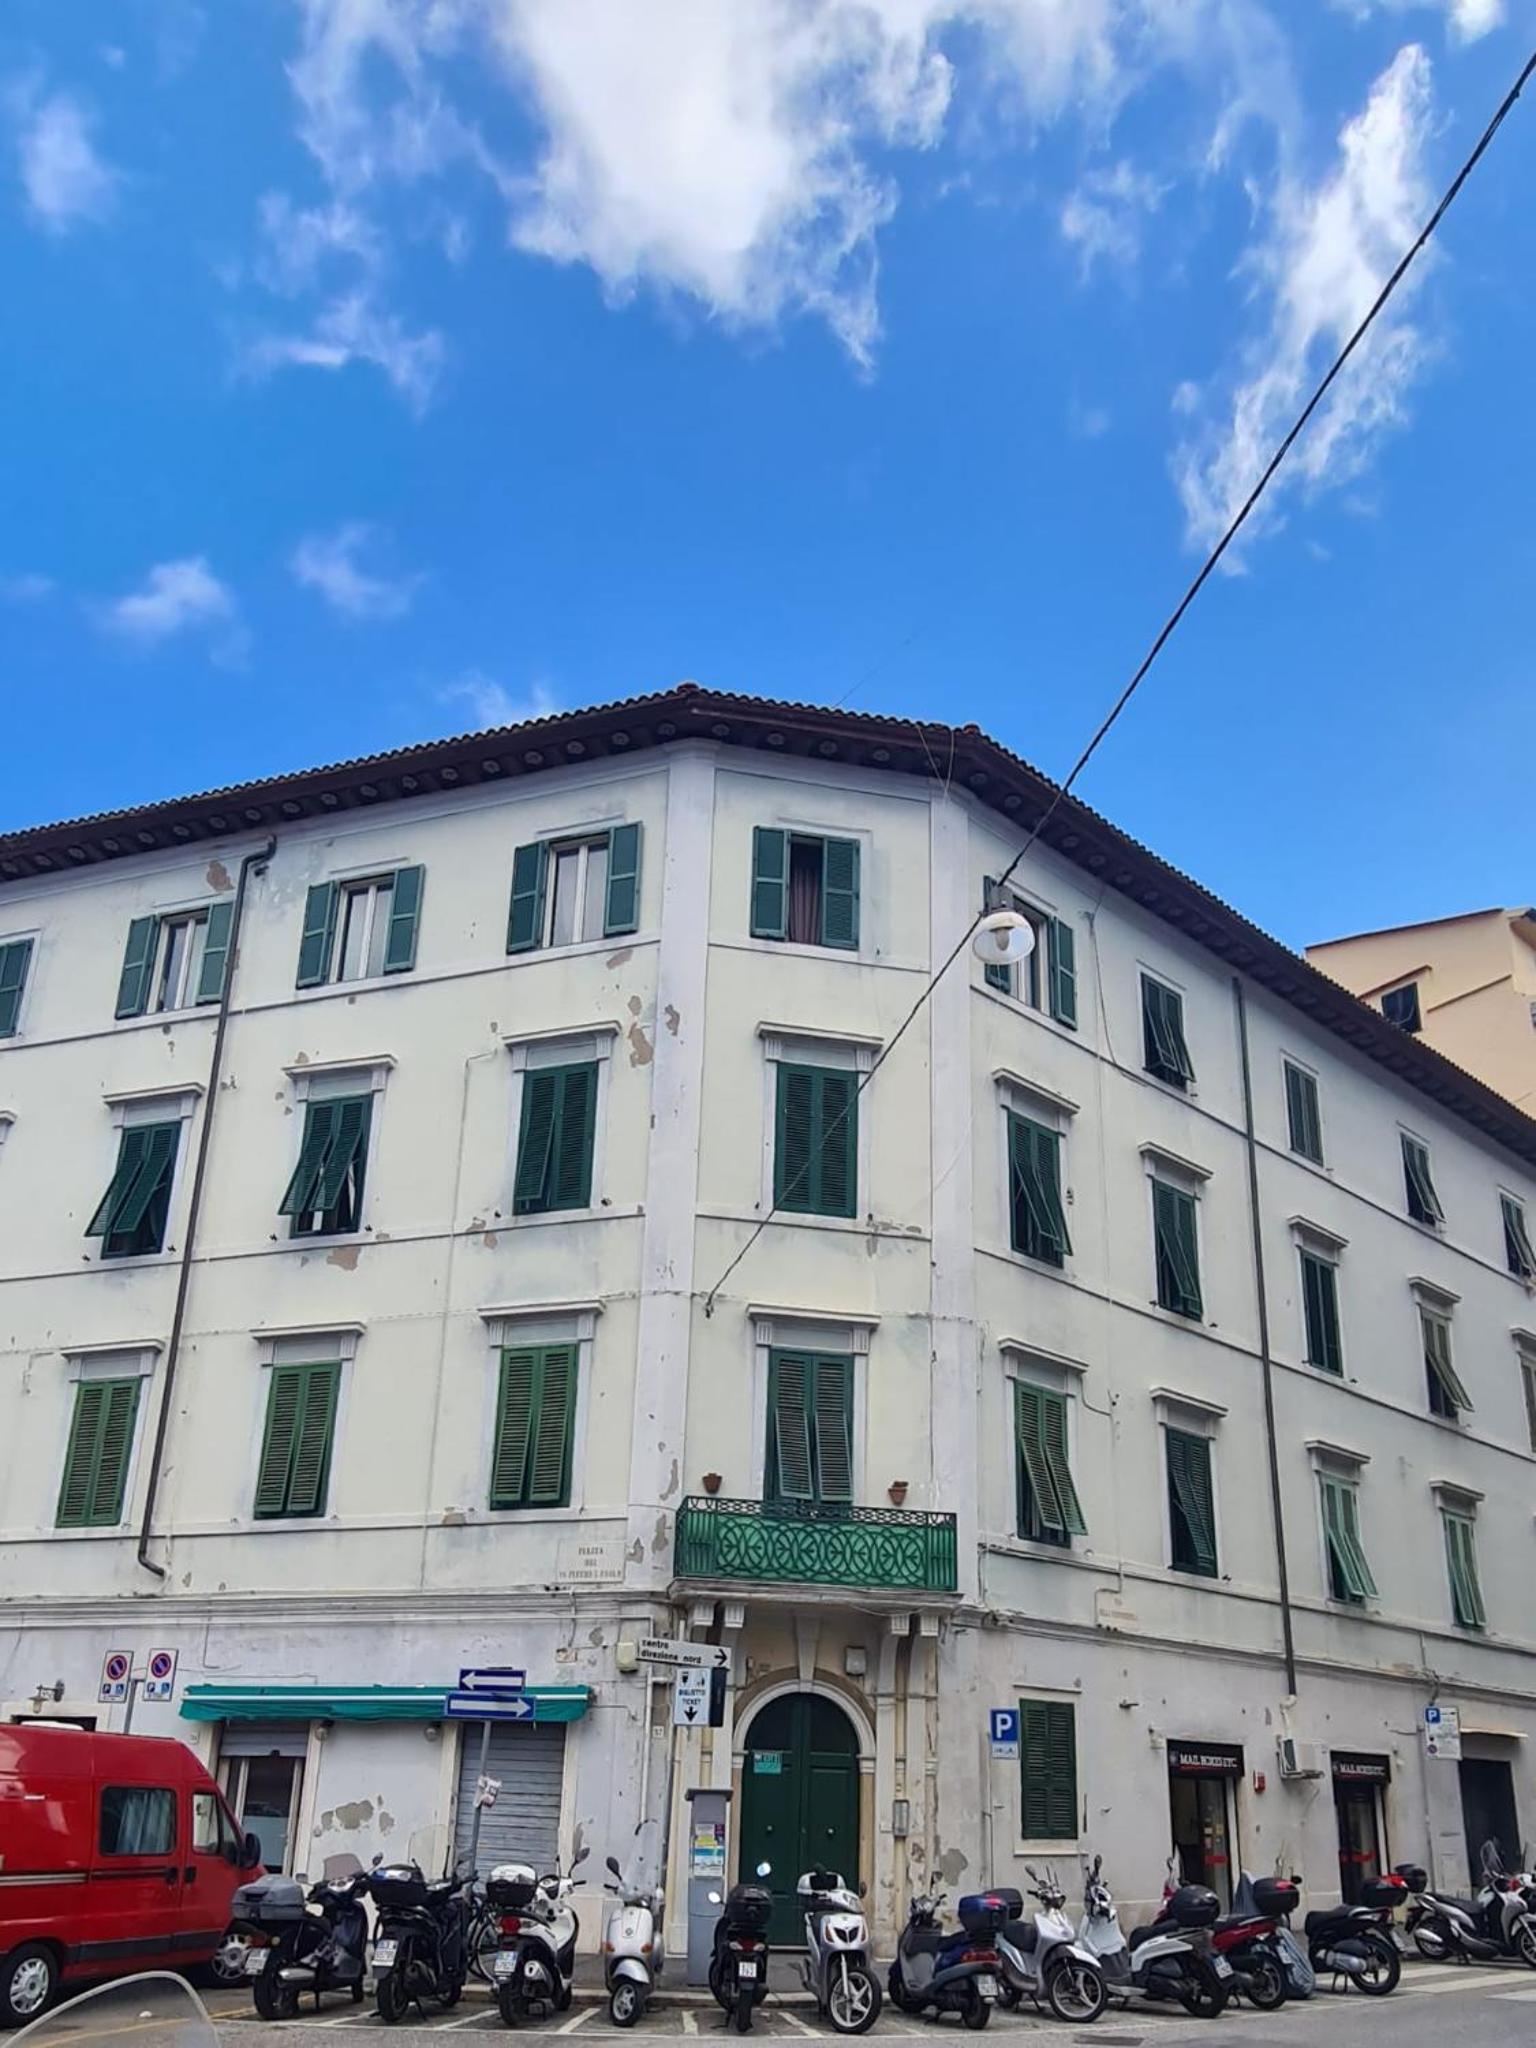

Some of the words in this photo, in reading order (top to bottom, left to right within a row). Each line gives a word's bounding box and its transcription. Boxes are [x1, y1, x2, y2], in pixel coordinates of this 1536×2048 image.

[641, 1640, 669, 1649] centro
[641, 1650, 678, 1660] direzione
[683, 1655, 702, 1663] nord
[1428, 1710, 1438, 1721] P
[996, 1713, 1012, 1739] P
[1180, 1754, 1200, 1765] MAIL
